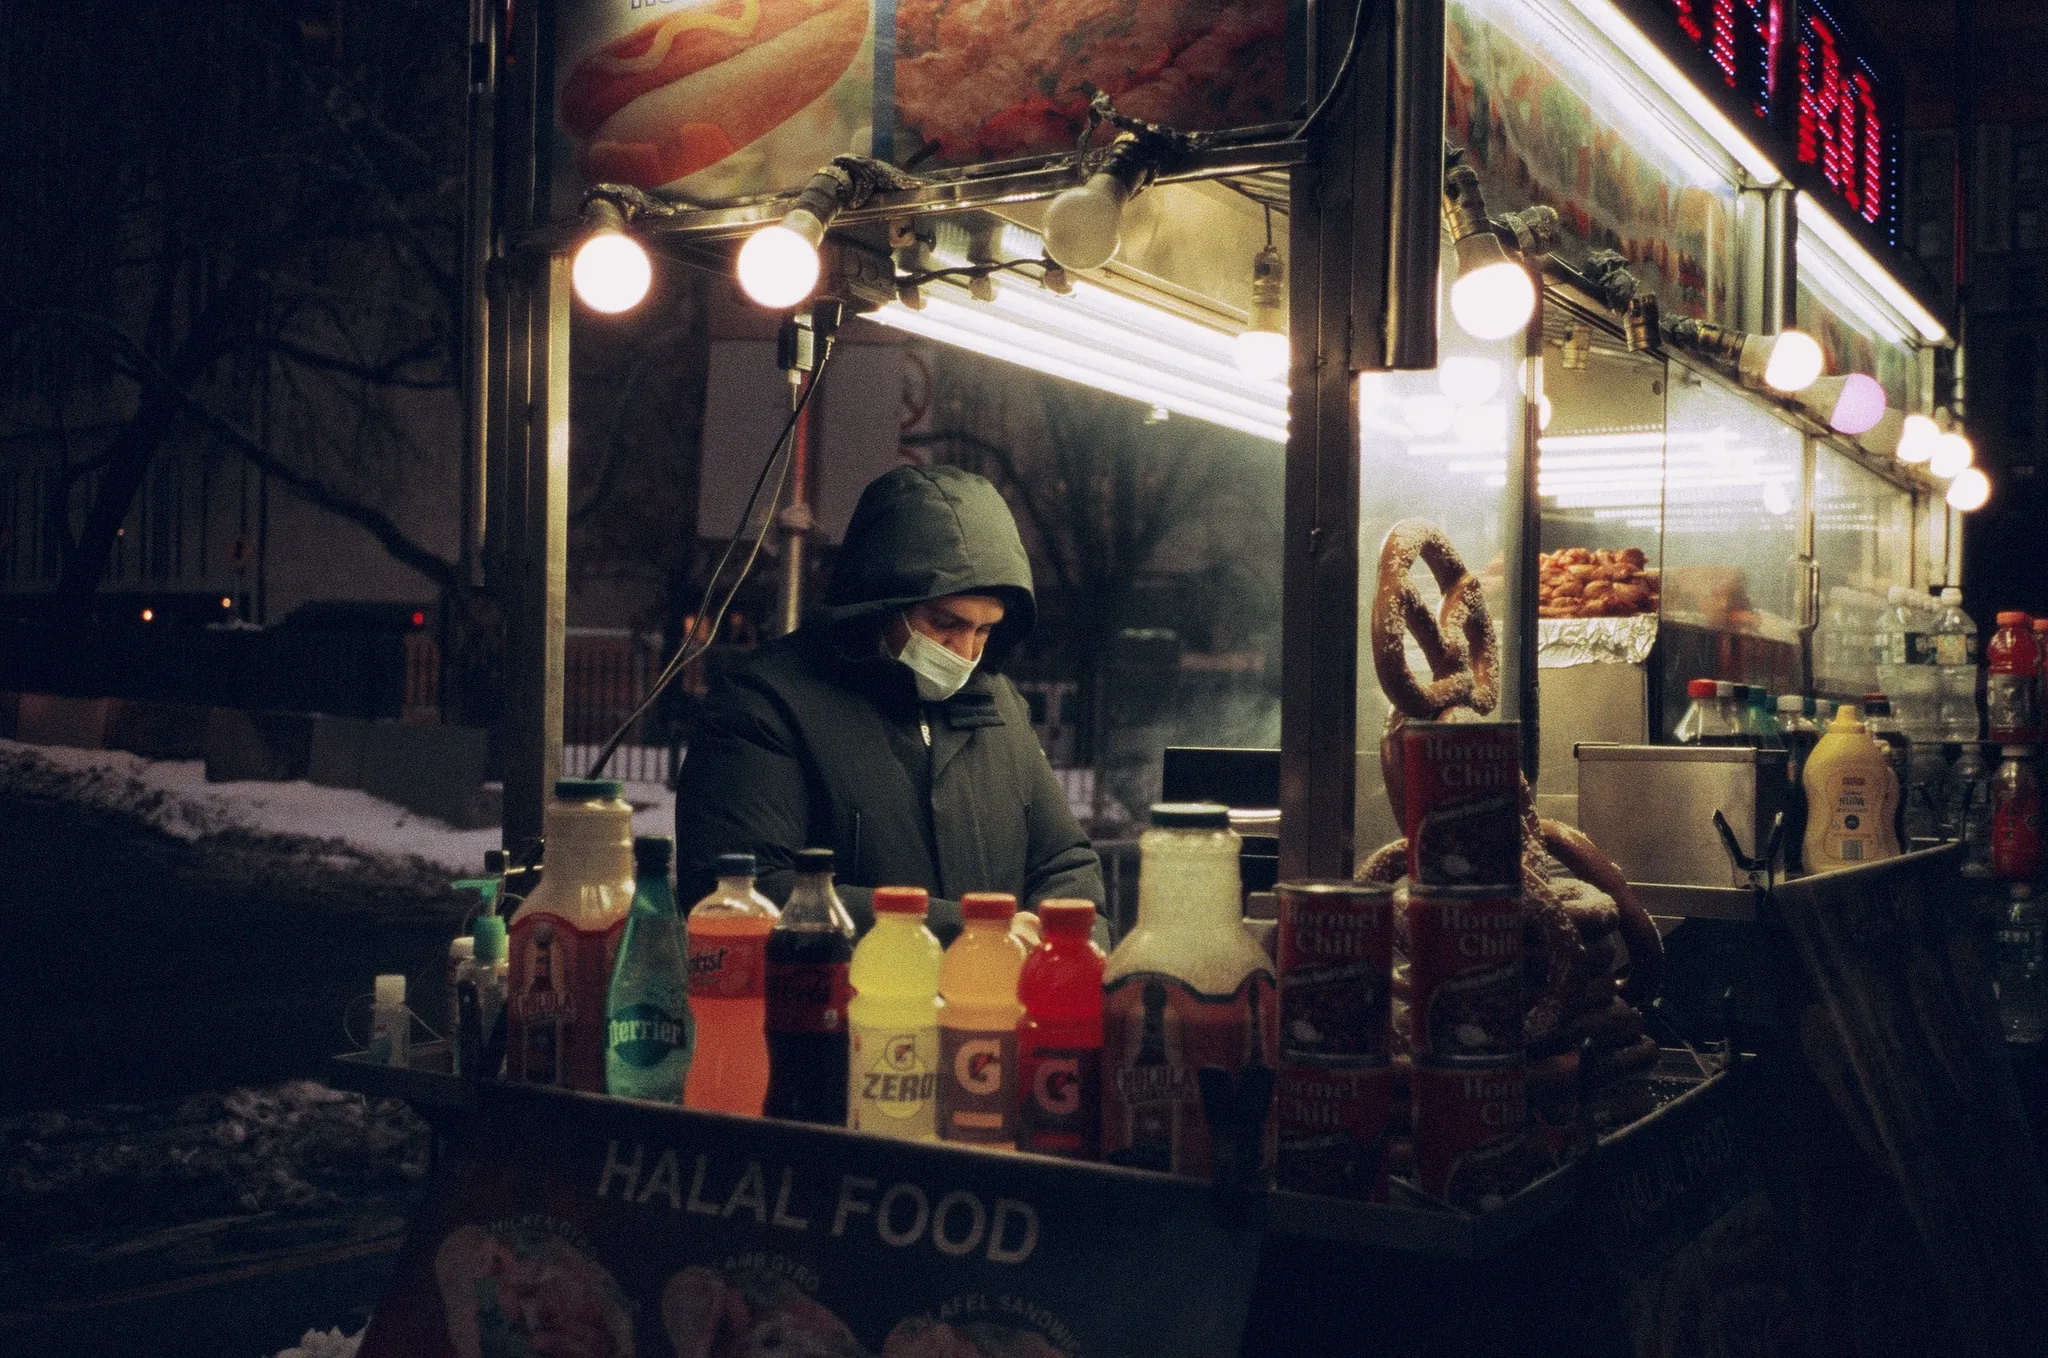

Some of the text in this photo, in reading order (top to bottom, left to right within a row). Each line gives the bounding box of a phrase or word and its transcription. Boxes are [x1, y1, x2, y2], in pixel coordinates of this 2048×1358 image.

[862, 1072, 936, 1102] ZERO
[954, 1038, 1001, 1096] G
[1033, 1058, 1079, 1116] G
[597, 1139, 1039, 1264] HALAL FOOD
[999, 1294, 1085, 1358] SANDWIC
